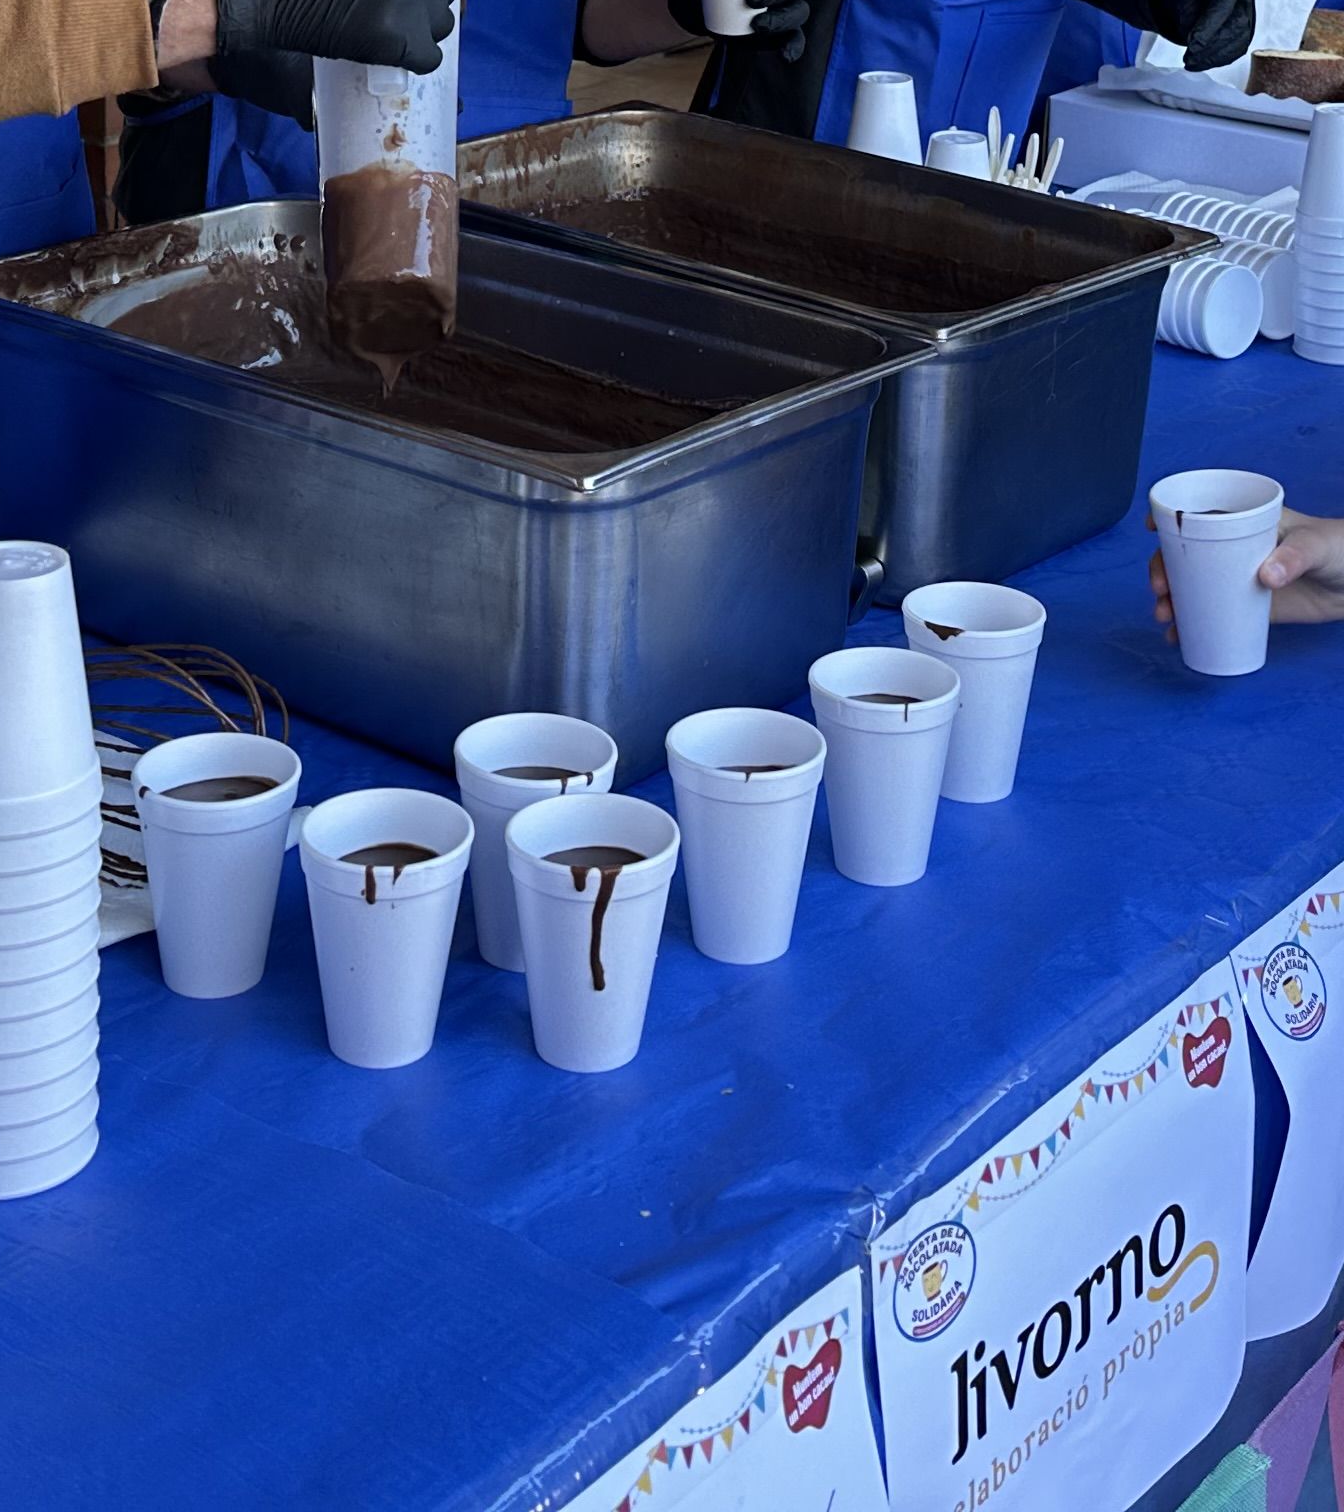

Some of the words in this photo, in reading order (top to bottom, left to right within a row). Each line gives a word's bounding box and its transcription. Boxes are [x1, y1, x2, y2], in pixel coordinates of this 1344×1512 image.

[904, 1240, 963, 1292] XOCOLATADA
[907, 1232, 937, 1265] FESTA
[940, 1227, 953, 1239] DE
[955, 1228, 967, 1241] LA
[911, 1280, 962, 1323] SOLIDÀRIA
[1102, 1300, 1186, 1401] pròpia
